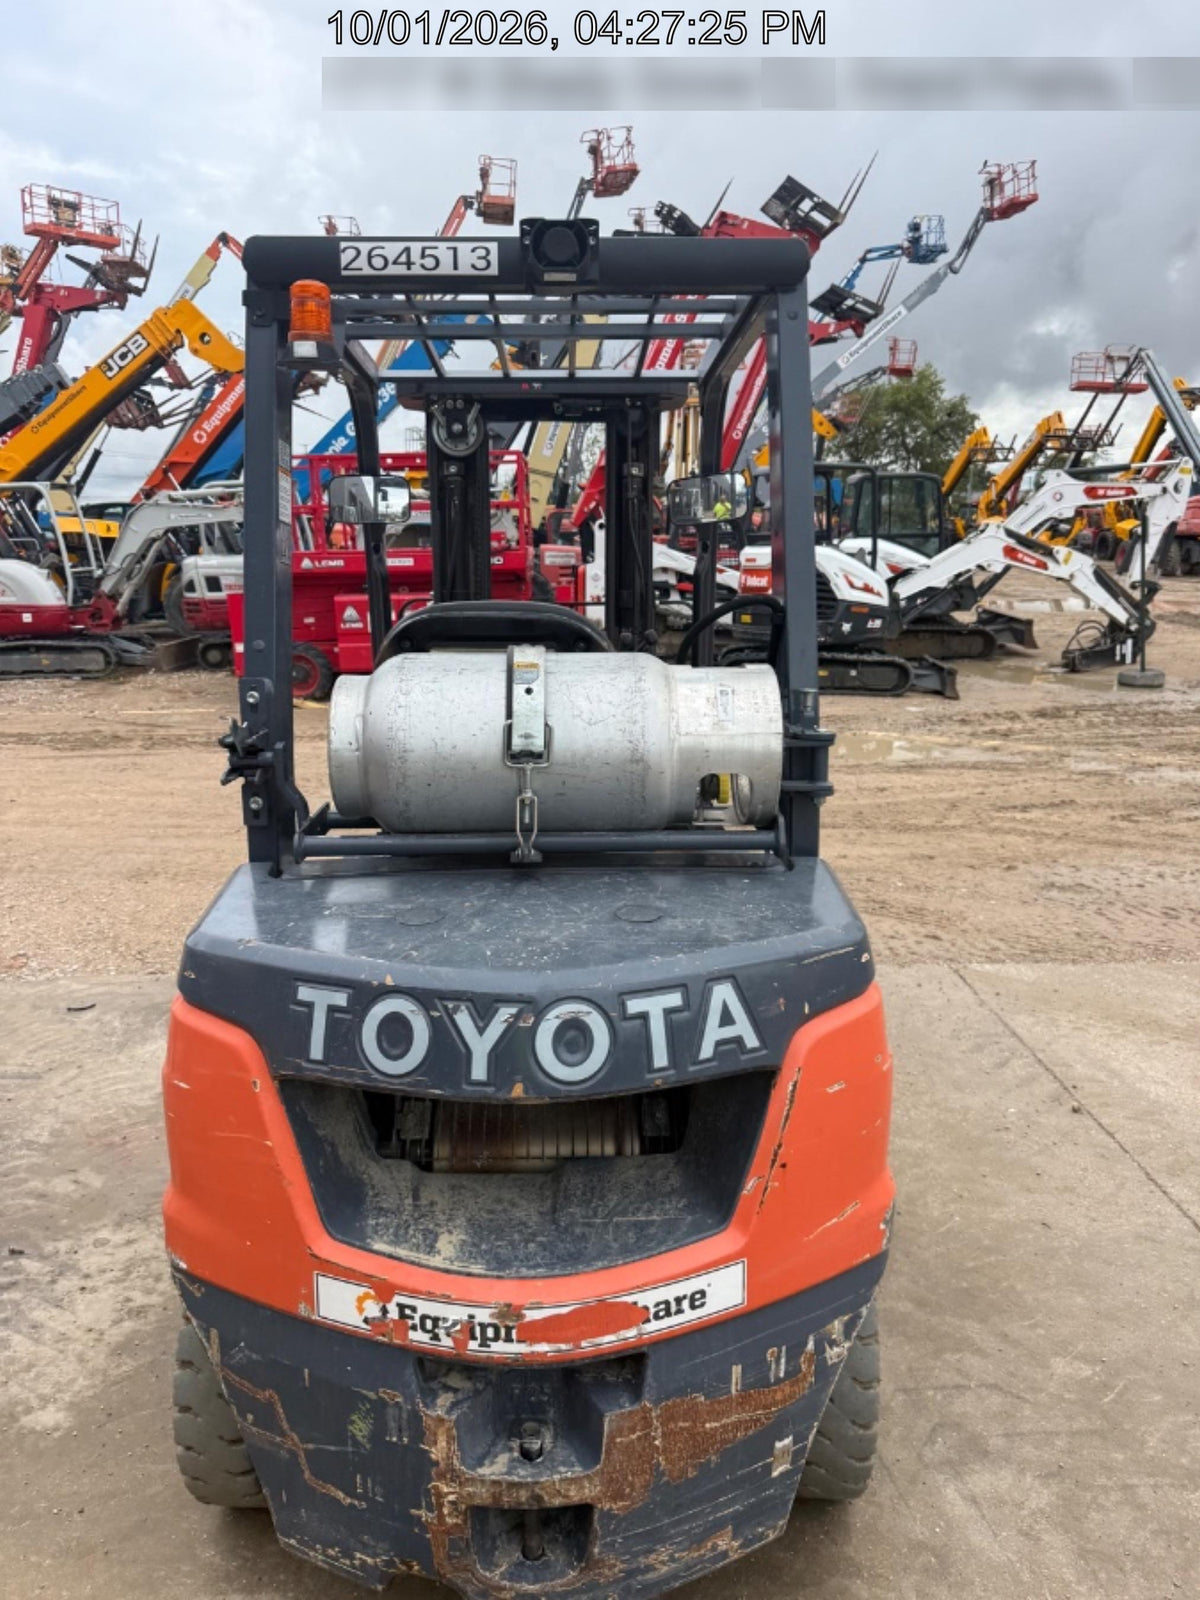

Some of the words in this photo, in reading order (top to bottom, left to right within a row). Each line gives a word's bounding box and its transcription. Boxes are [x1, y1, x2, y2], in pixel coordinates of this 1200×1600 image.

[341, 246, 492, 271] 264513
[104, 333, 149, 379] JCB
[296, 981, 761, 1083] TOYOTA
